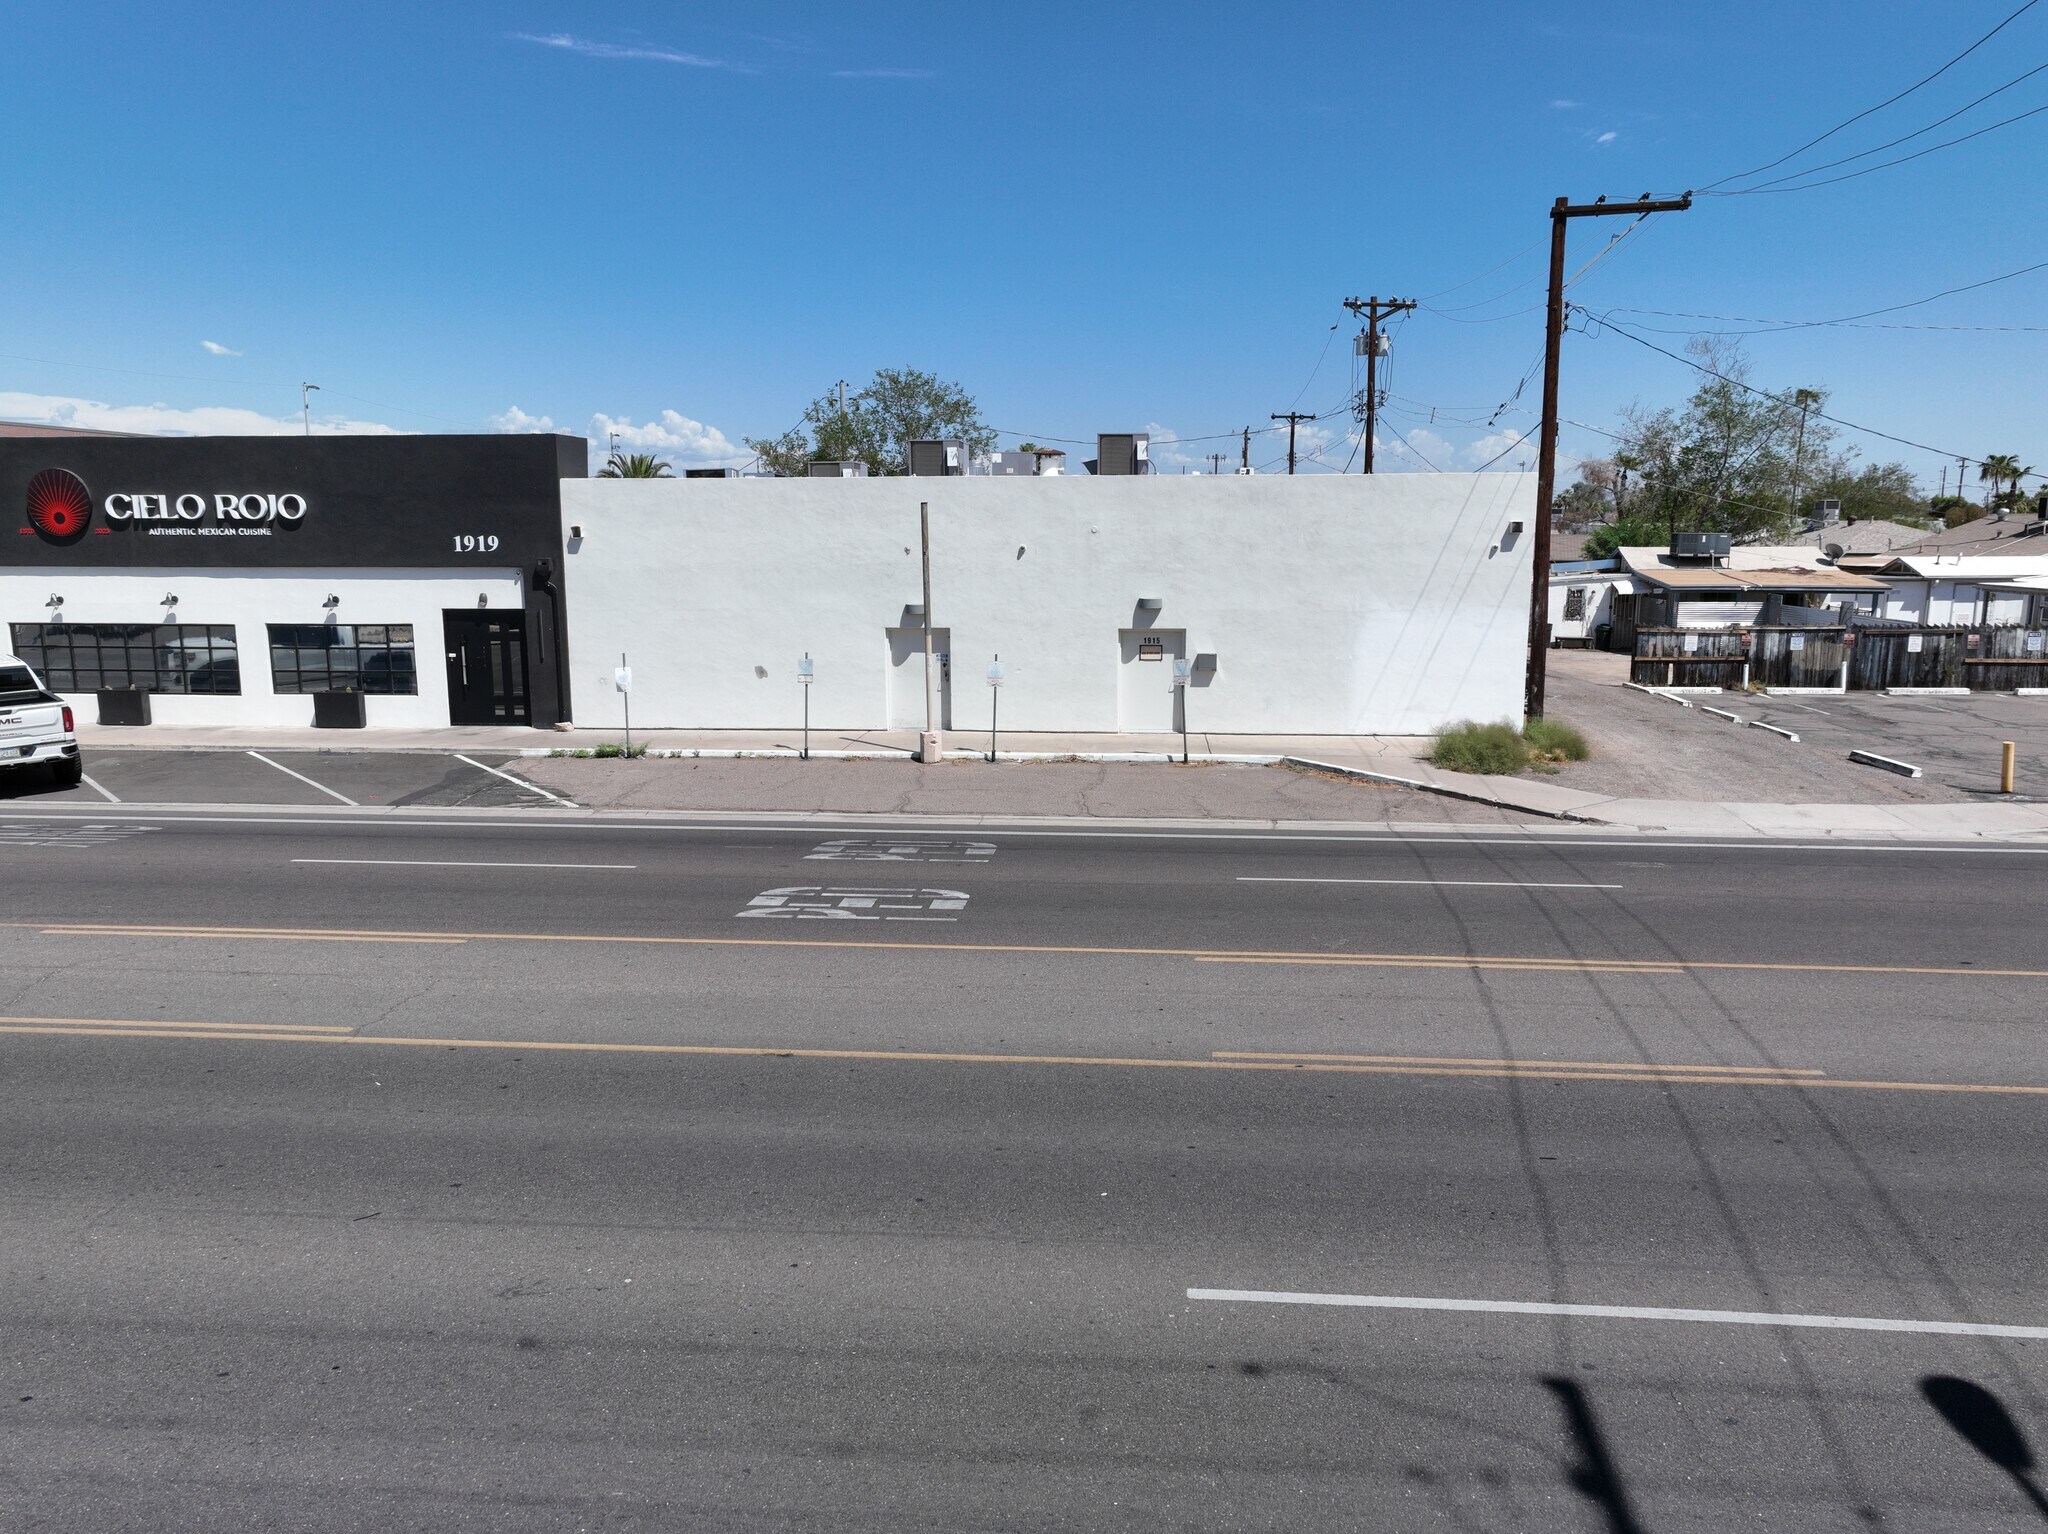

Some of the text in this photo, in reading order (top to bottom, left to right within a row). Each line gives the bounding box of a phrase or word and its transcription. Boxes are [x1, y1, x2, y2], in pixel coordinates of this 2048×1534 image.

[104, 493, 307, 521] CIELO ROJO
[148, 527, 272, 536] AUTHENTIC MEXICAN CUISINE
[453, 535, 499, 552] 1919
[0, 717, 22, 725] MC
